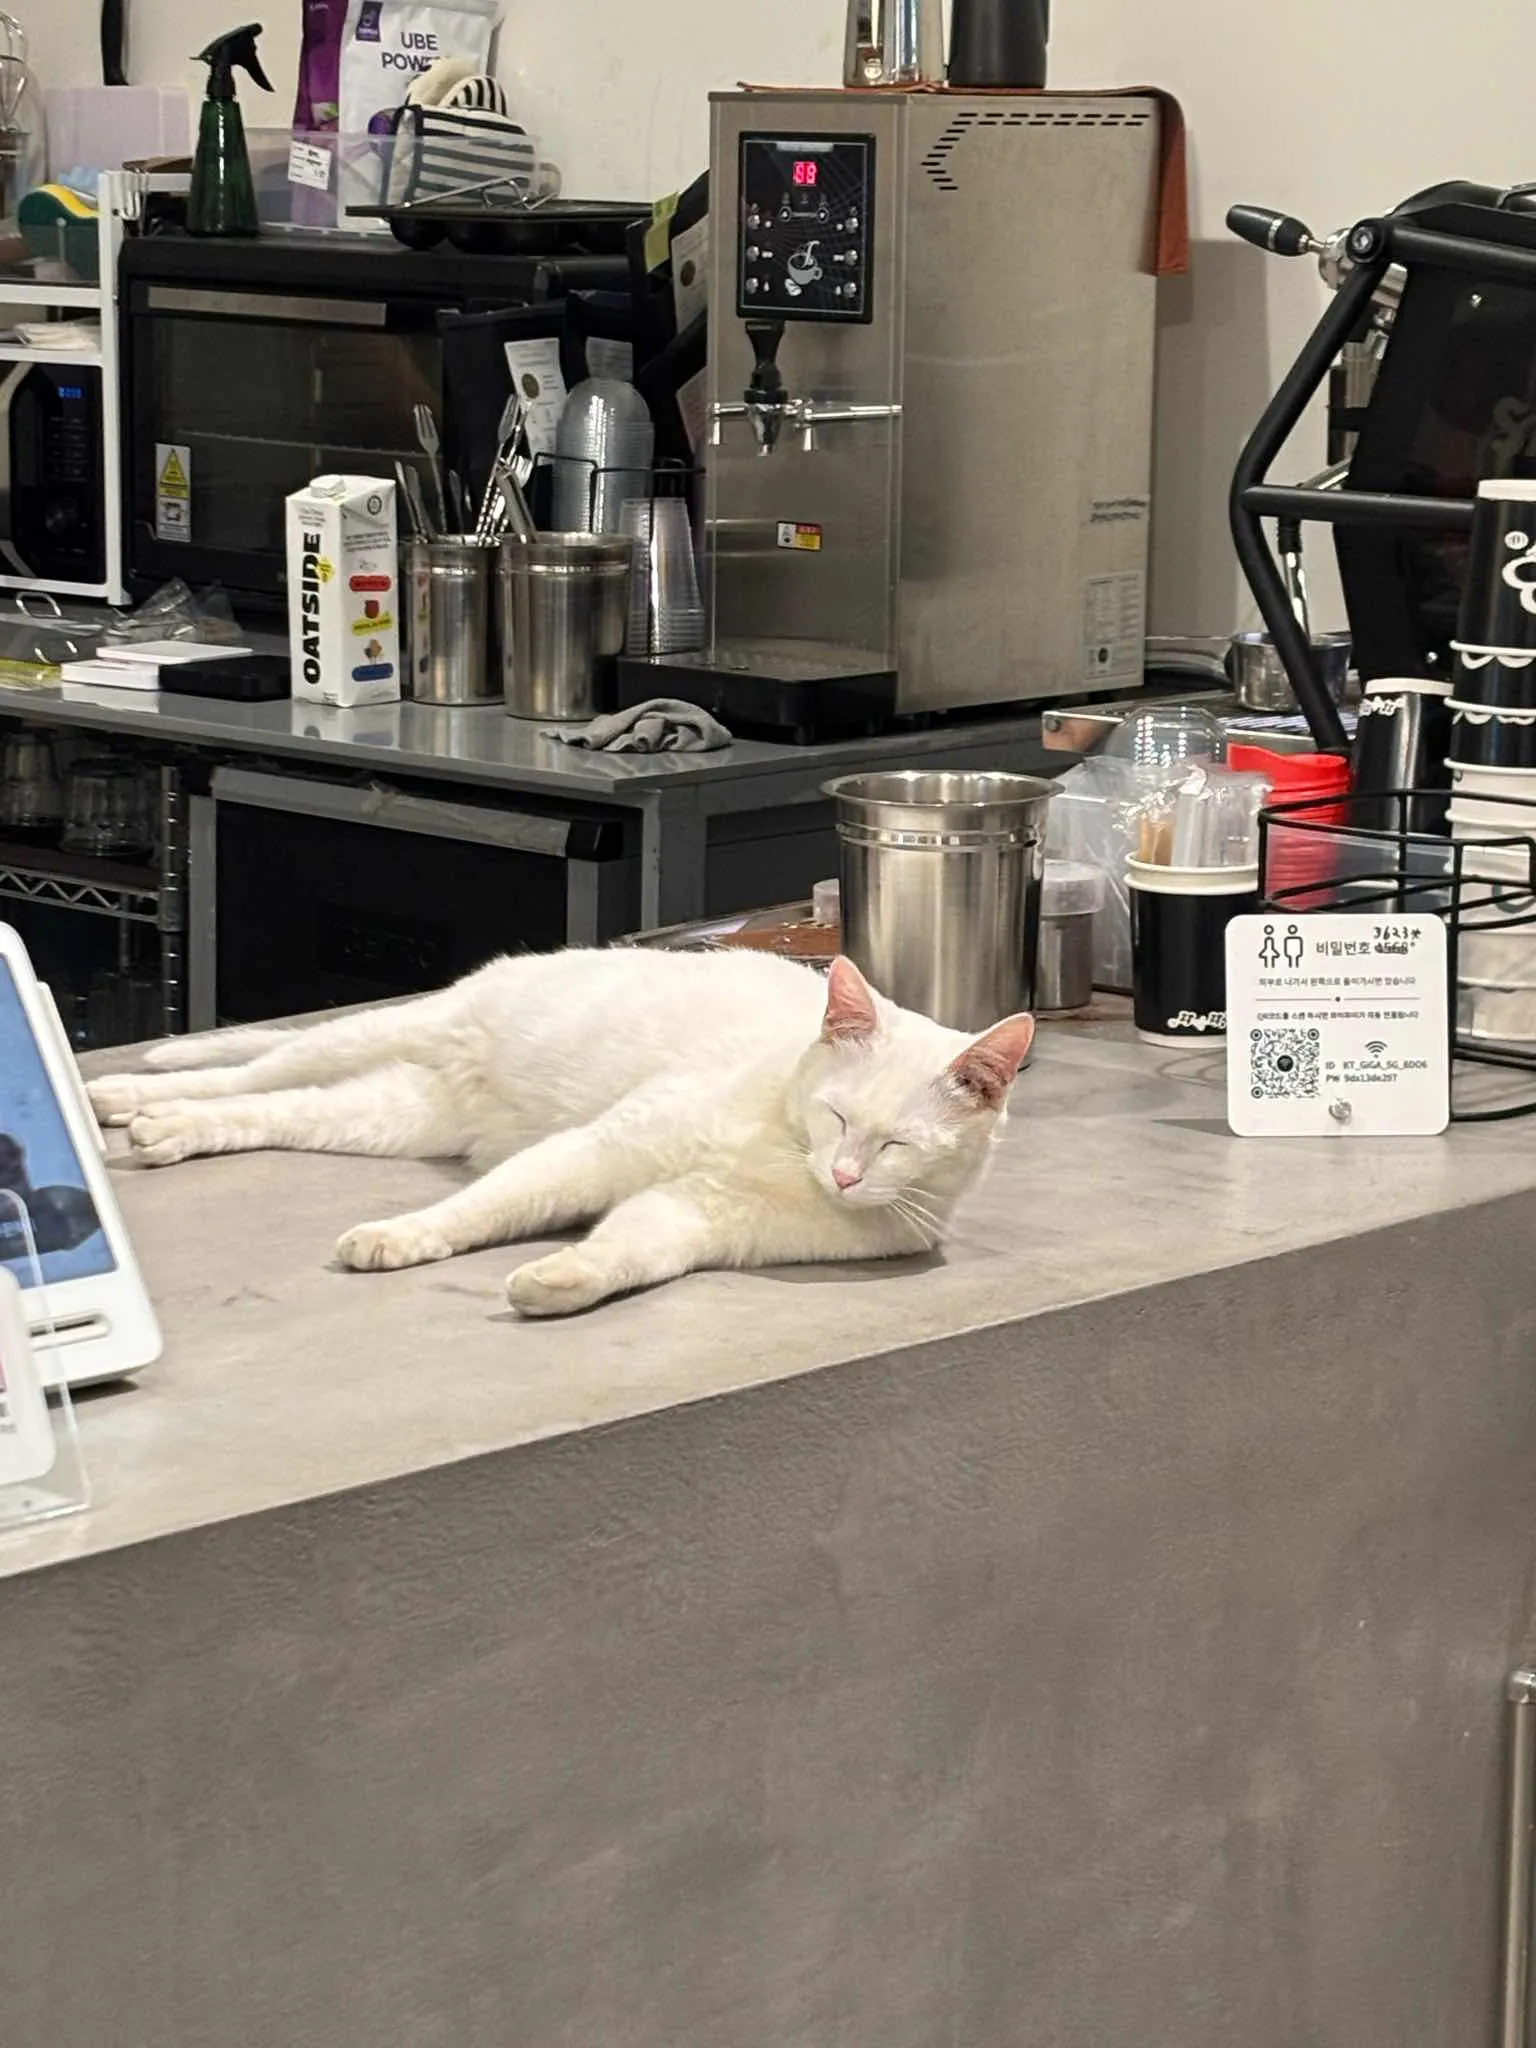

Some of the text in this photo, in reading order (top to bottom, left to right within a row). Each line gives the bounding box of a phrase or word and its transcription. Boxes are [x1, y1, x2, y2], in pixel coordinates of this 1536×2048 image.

[401, 31, 438, 50] UBE
[302, 532, 321, 684] OATSIDE
[1316, 940, 1371, 956] 비밀번호
[1325, 1061, 1336, 1070] ID
[1326, 1074, 1340, 1082] PW
